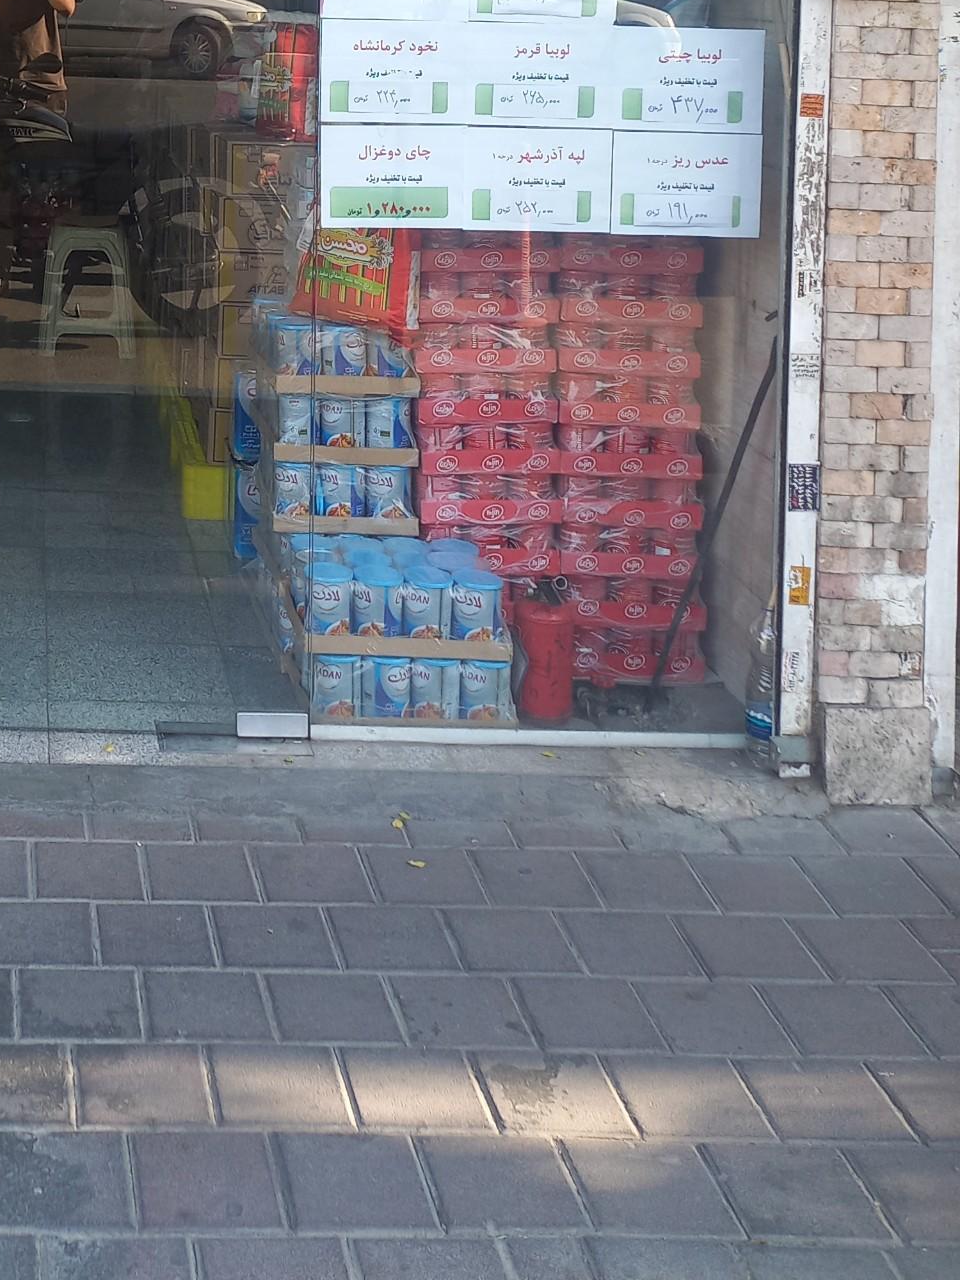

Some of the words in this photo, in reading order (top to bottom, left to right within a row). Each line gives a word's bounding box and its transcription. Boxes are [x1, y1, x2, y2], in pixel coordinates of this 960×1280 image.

[354, 40, 405, 55] کرمانشاه
[410, 40, 438, 55] نخود
[514, 43, 540, 58] قرمز
[546, 44, 570, 59] لوبیا
[659, 50, 692, 64] چیتی
[697, 48, 721, 64] لوبیا
[366, 68, 379, 78] ویژه
[512, 72, 525, 81] ویژه
[527, 73, 547, 81] تخفیف
[554, 74, 569, 82] قیمت
[660, 77, 673, 86] ویژه
[675, 78, 695, 86] تخفیف
[702, 79, 717, 87] قیمت
[359, 145, 401, 160] دوغزال
[406, 145, 431, 160] چای
[517, 147, 564, 163] آذرشهر
[568, 149, 585, 164] لپه
[672, 155, 690, 168] ریز
[696, 156, 728, 168] عدس
[366, 174, 379, 182] ویژه
[381, 175, 400, 183] تخفیف
[408, 175, 422, 184] قیمت
[509, 177, 522, 186] ویژه
[524, 178, 544, 187] تخفیف
[551, 178, 565, 187] قیمت
[657, 182, 670, 191] ویژه
[672, 182, 692, 191] تخفیف
[700, 184, 714, 192] قیمت
[348, 208, 362, 216] تومان
[321, 236, 367, 255] محسن
[313, 590, 340, 602] لادن
[455, 594, 482, 608] لادن
[318, 667, 342, 680] ADAN
